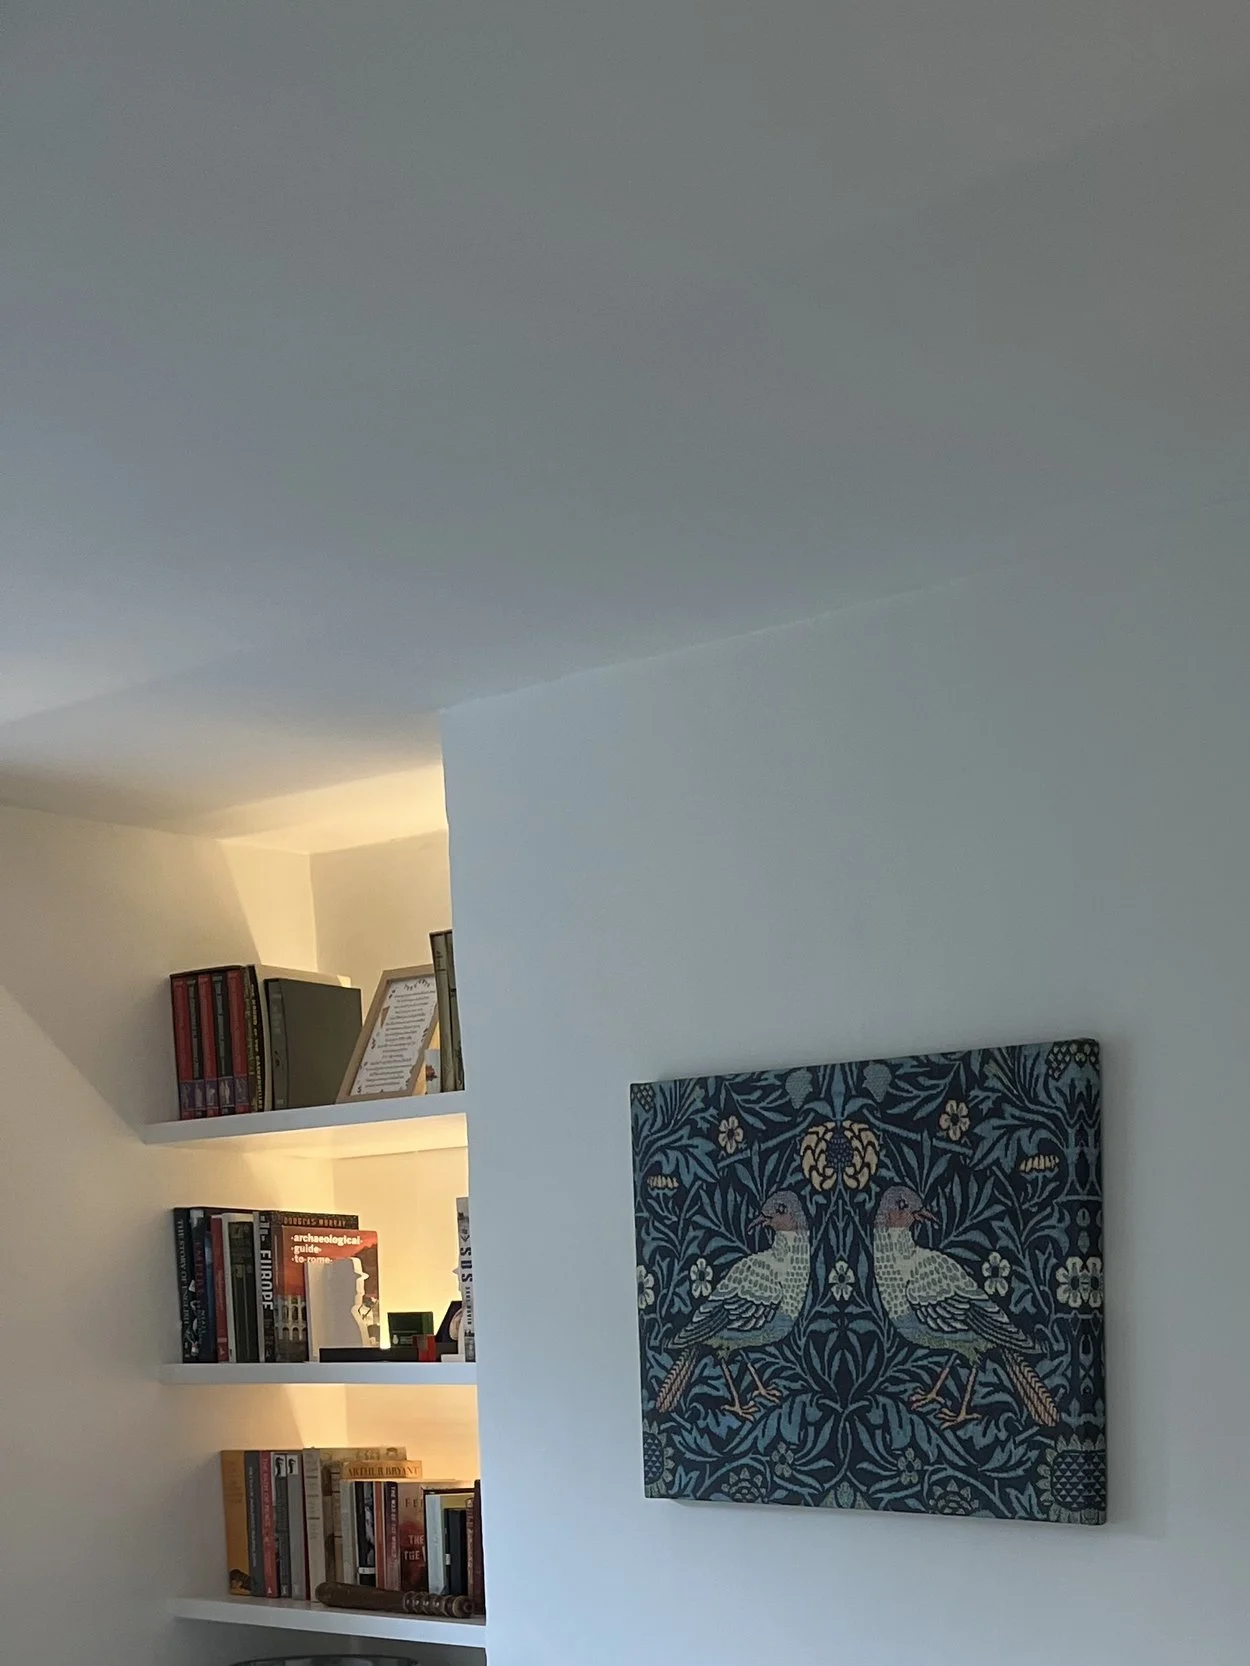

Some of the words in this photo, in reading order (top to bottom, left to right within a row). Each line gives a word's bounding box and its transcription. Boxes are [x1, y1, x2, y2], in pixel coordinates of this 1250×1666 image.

[293, 1233, 361, 1246] archaeological
[293, 1244, 319, 1254] guide
[385, 1466, 418, 1476] BRYANT
